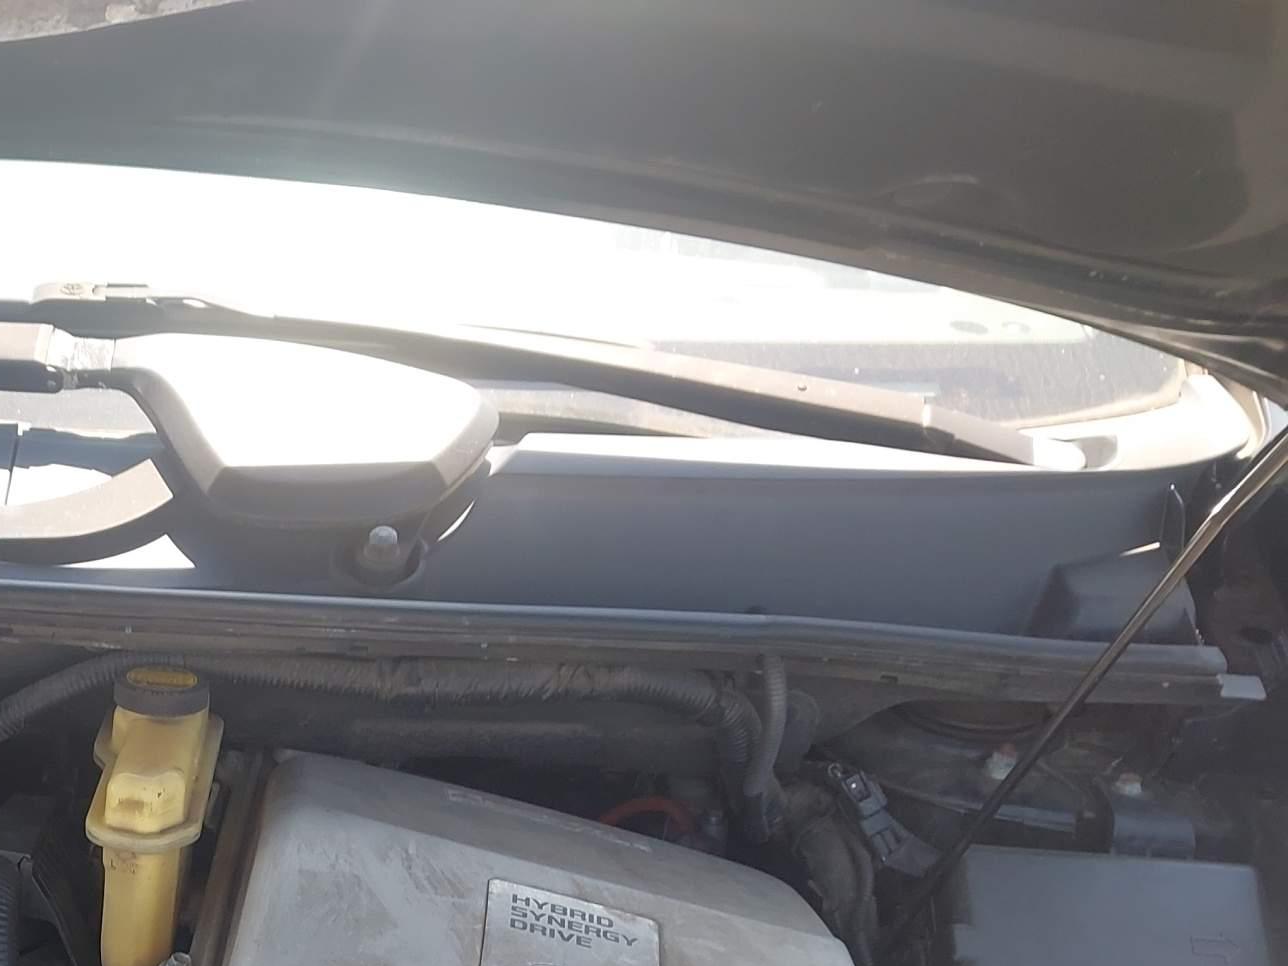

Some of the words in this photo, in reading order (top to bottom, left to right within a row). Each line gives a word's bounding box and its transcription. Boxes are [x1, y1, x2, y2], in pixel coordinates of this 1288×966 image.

[510, 905, 639, 947] SYNERGY
[512, 893, 614, 929] HYBRID
[509, 917, 593, 949] DRIVE
